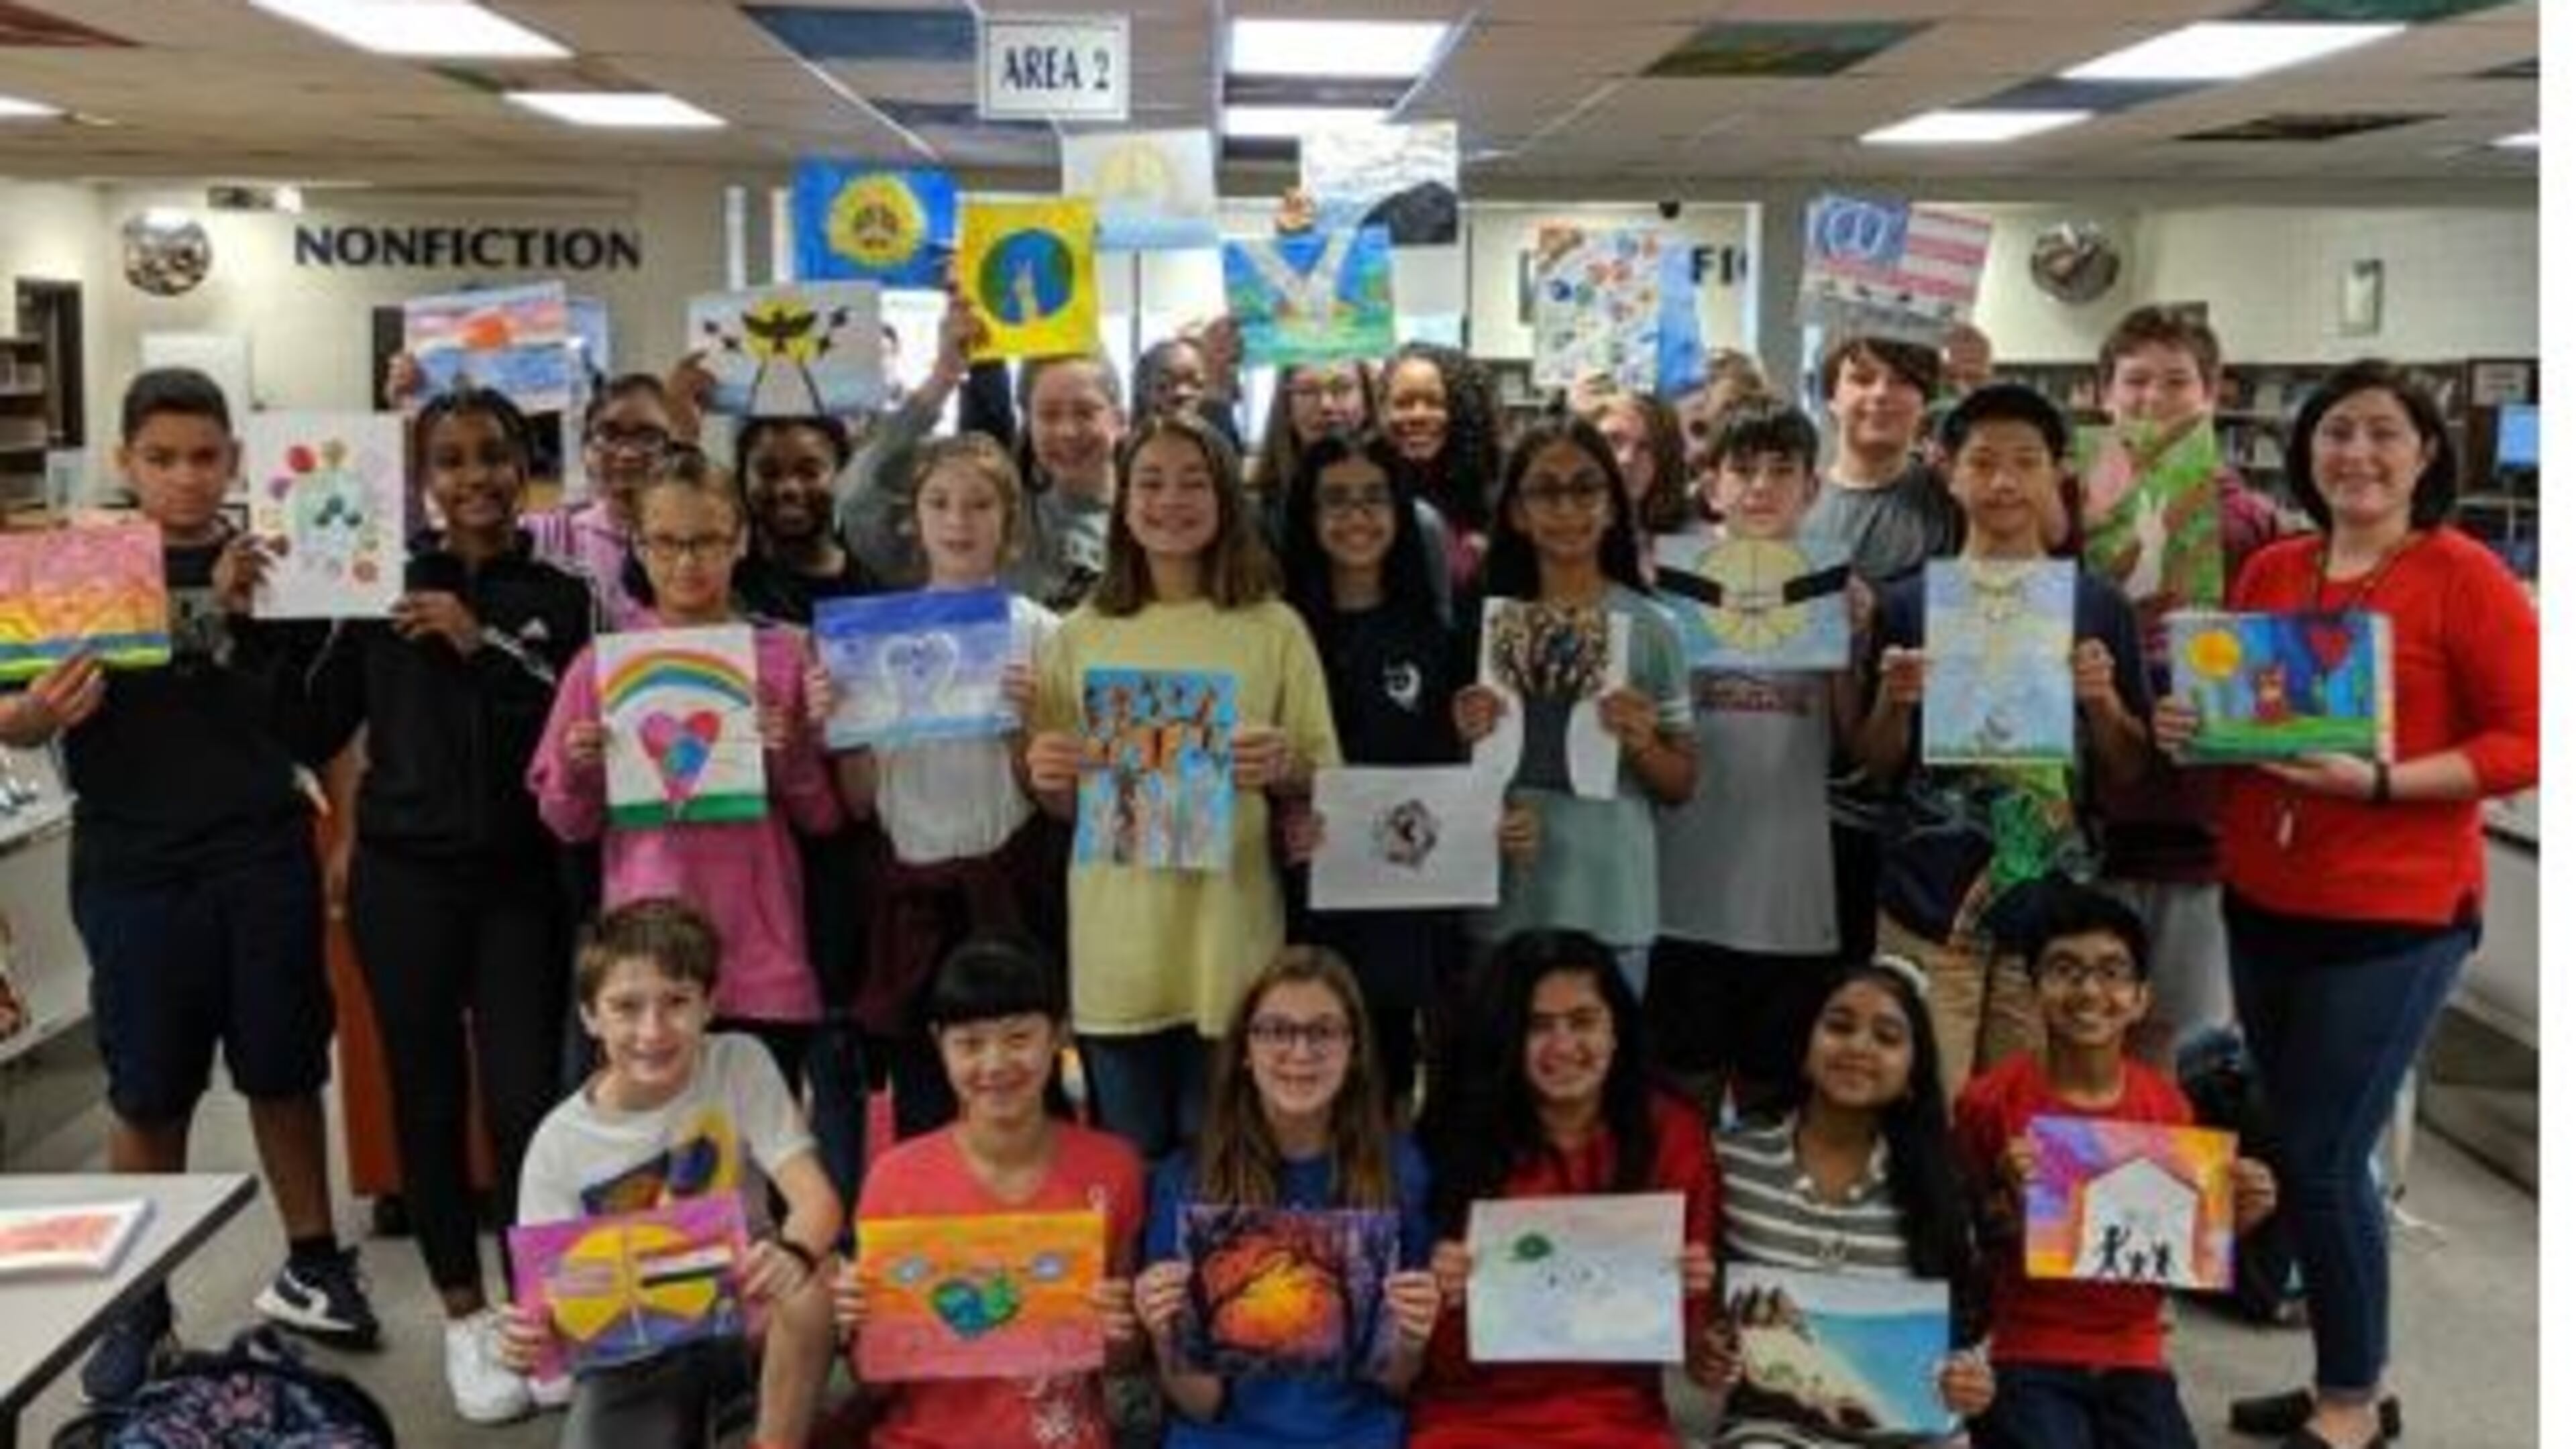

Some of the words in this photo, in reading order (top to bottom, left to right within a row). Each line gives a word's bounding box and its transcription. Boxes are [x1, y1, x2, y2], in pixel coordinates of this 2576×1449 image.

[1000, 46, 1082, 90] AREA
[1093, 48, 1110, 89] 2
[295, 225, 641, 269] NONFICTION
